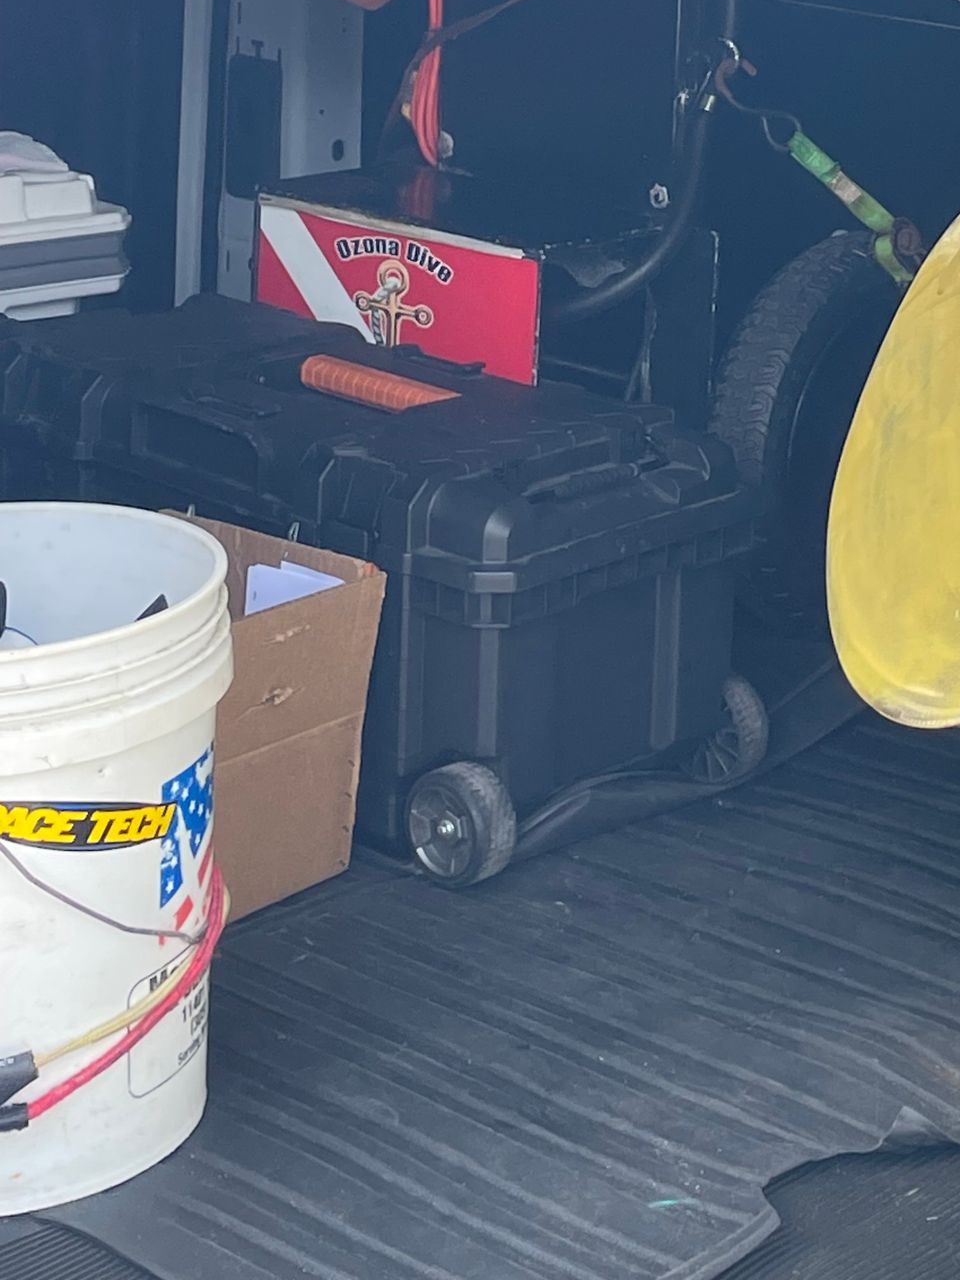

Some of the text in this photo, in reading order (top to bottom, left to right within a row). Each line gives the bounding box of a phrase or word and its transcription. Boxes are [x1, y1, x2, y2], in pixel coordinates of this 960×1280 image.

[336, 237, 453, 283] Ozona Dive
[86, 803, 177, 844] TECH
